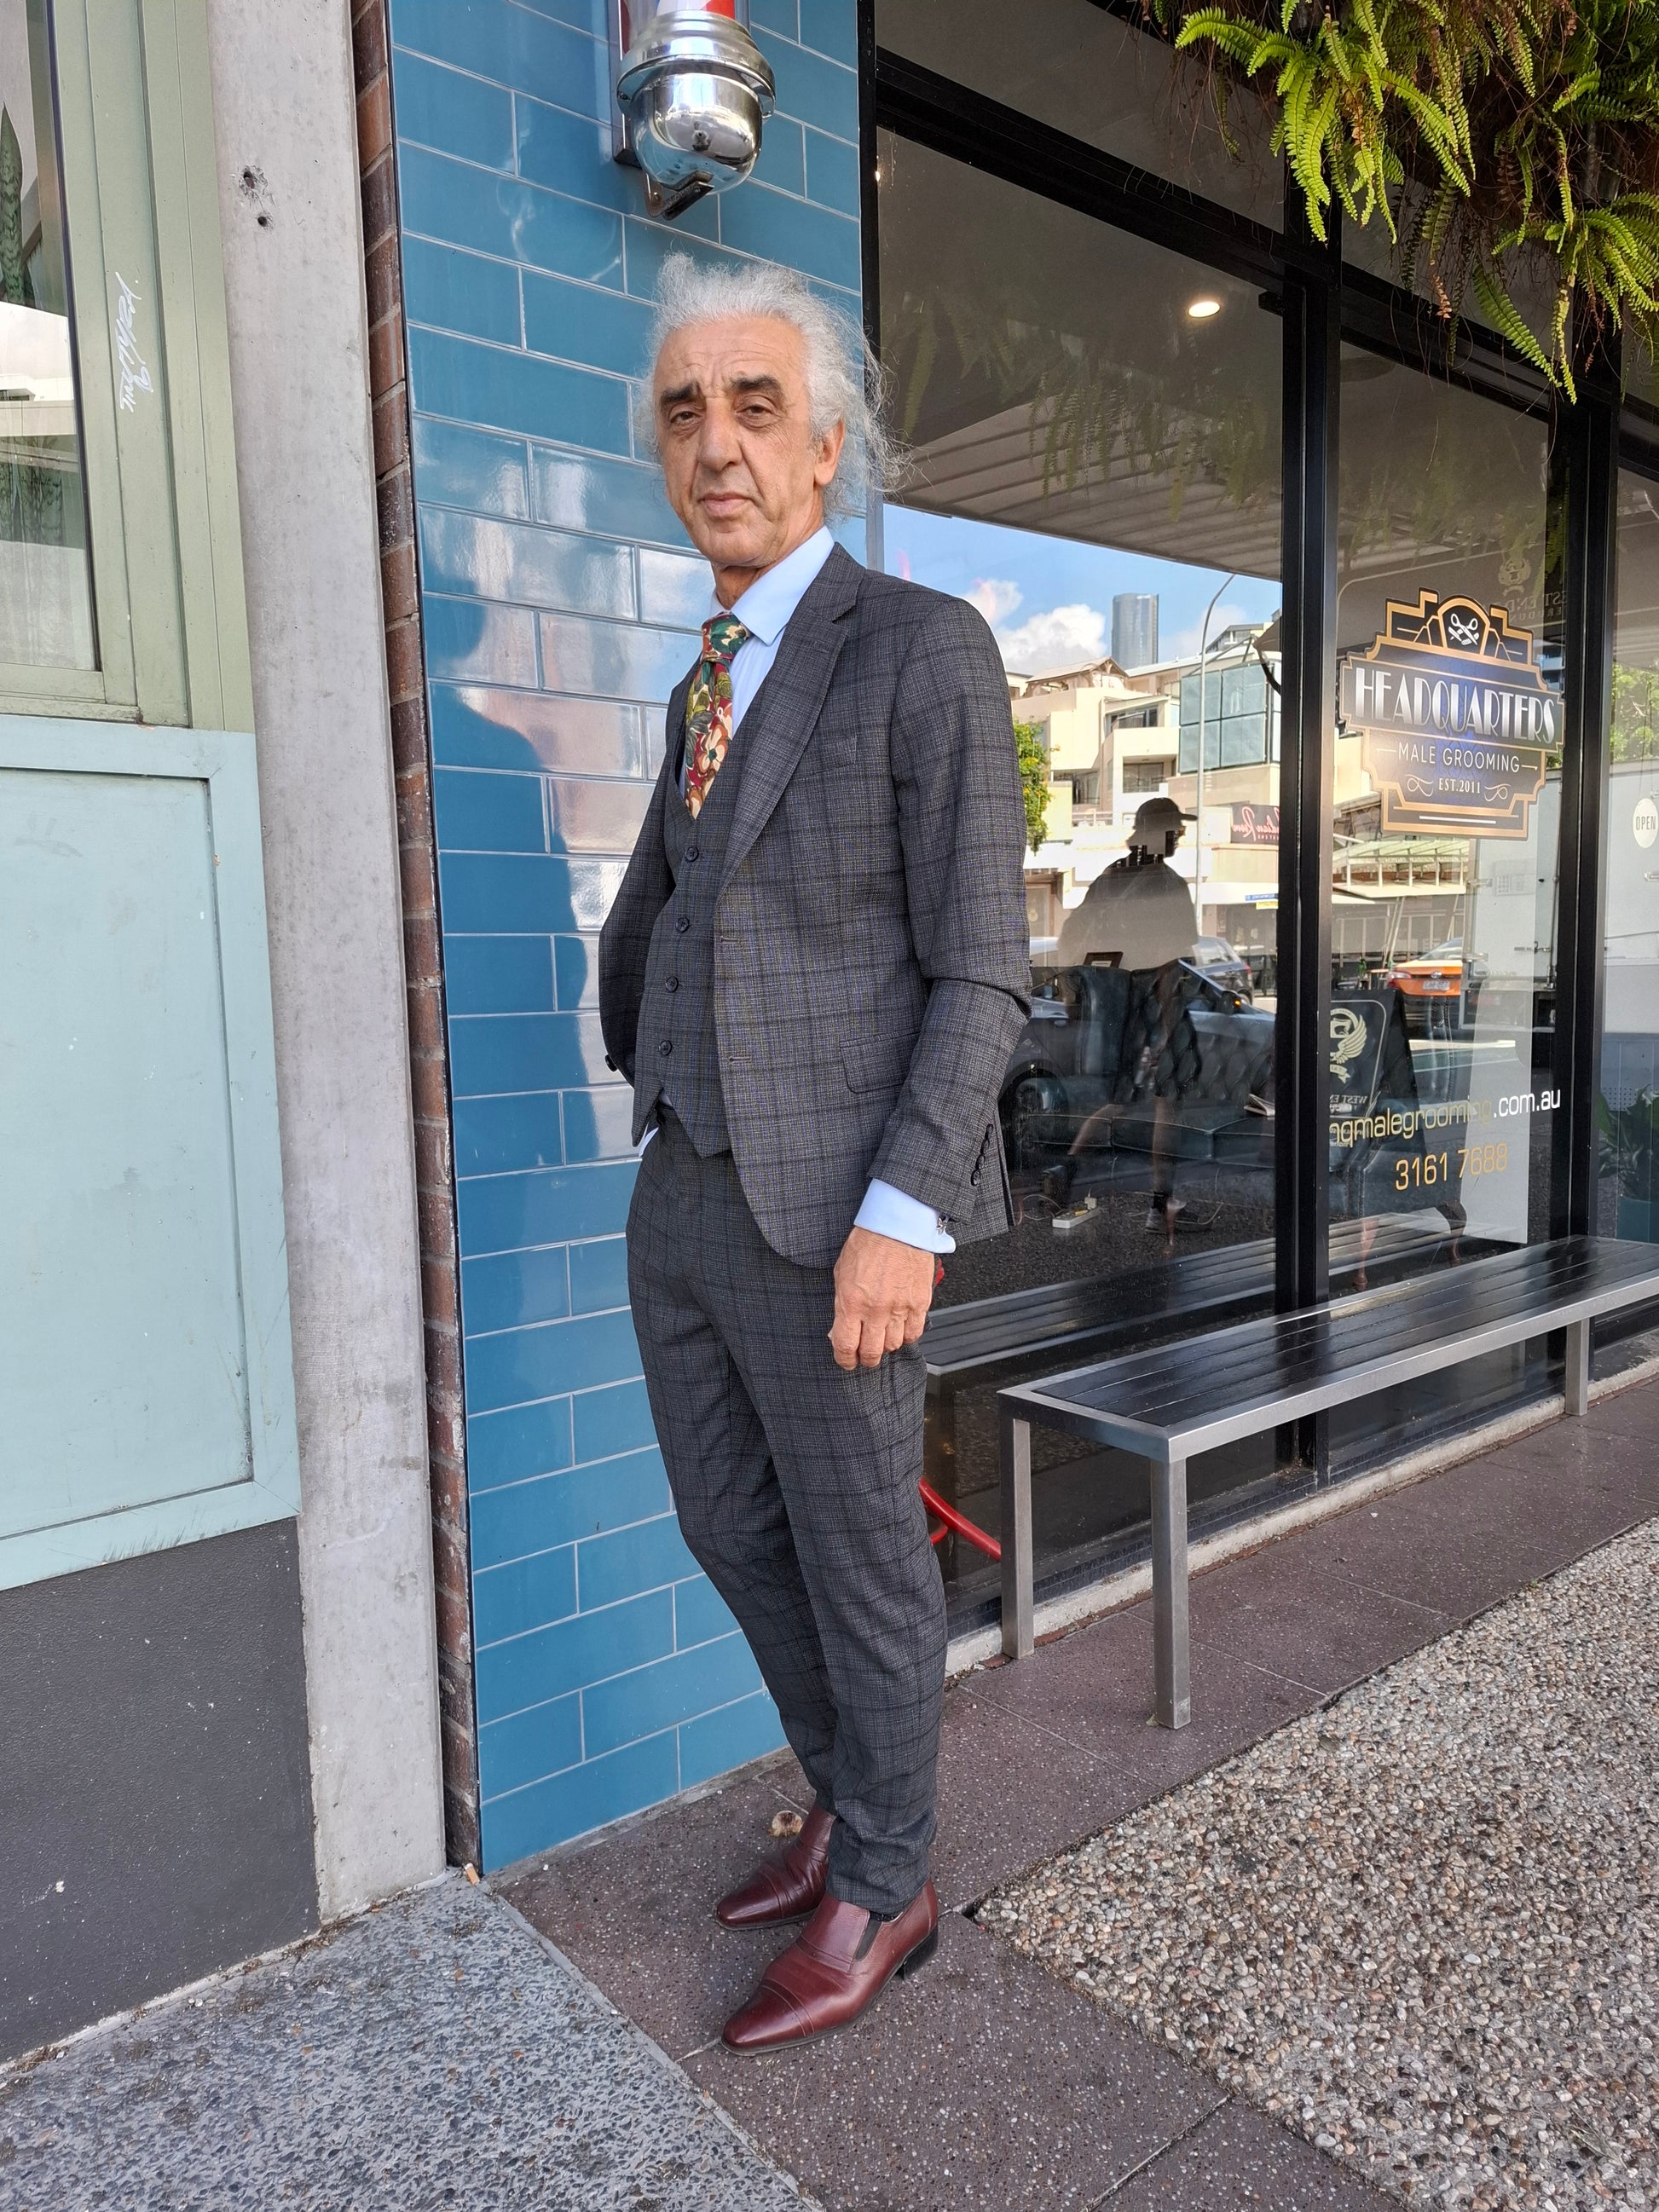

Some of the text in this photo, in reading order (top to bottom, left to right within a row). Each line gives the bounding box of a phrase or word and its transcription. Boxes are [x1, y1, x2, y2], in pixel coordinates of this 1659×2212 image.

[1355, 667, 1555, 744] HEADQUARTERS
[1398, 743, 1520, 773] MALE GROOMING
[1438, 777, 1481, 794] EST.2011
[1635, 816, 1656, 830] OPEN
[1395, 1142, 1508, 1192] 3161 7688
